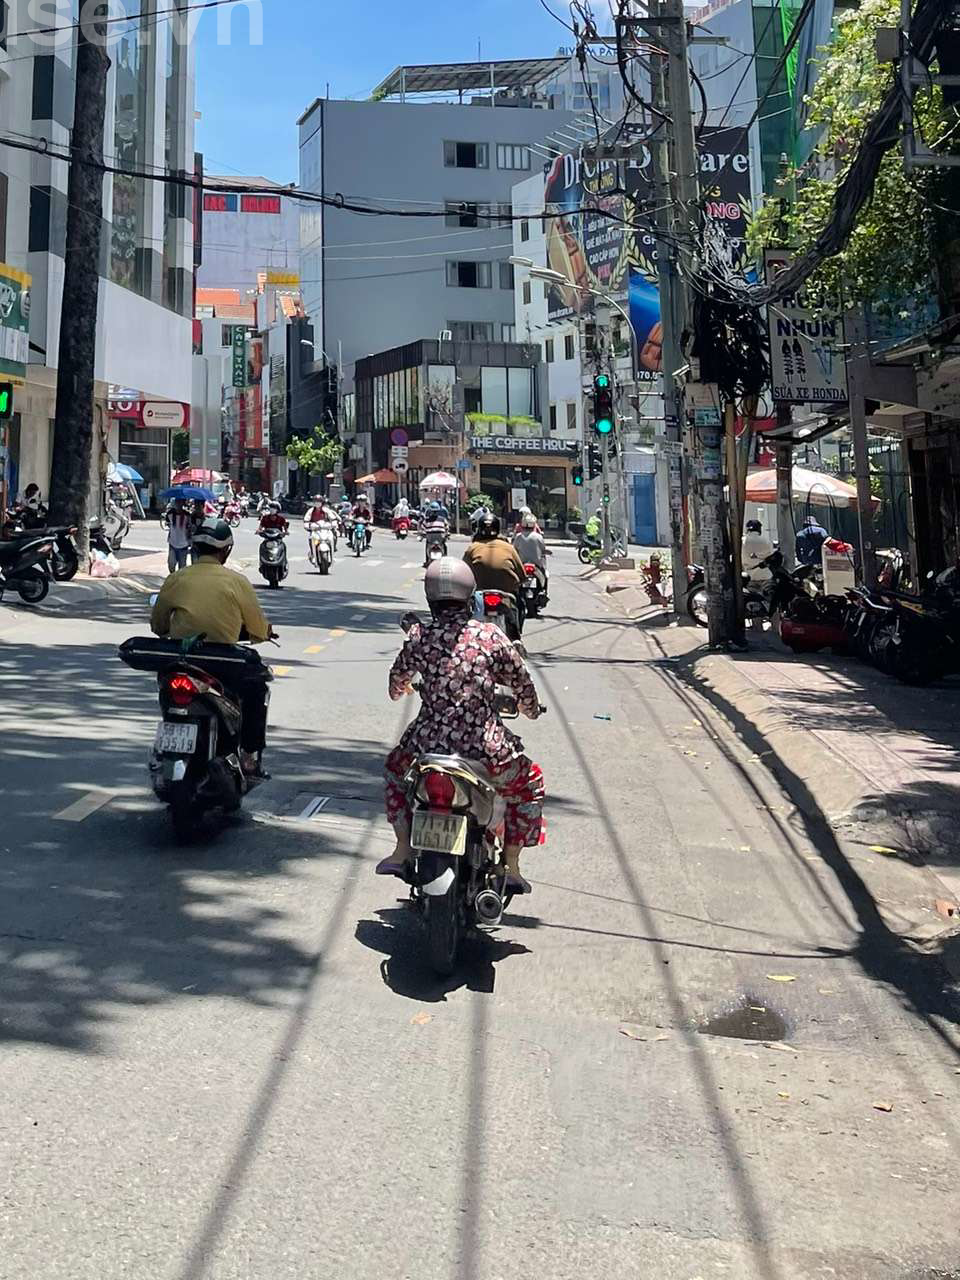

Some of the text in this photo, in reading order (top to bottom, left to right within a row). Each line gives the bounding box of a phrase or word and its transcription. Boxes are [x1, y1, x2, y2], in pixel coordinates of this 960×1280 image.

[796, 387, 809, 398] XE
[812, 388, 846, 400] HONDA
[471, 437, 493, 449] THE
[495, 438, 540, 450] COFFEE
